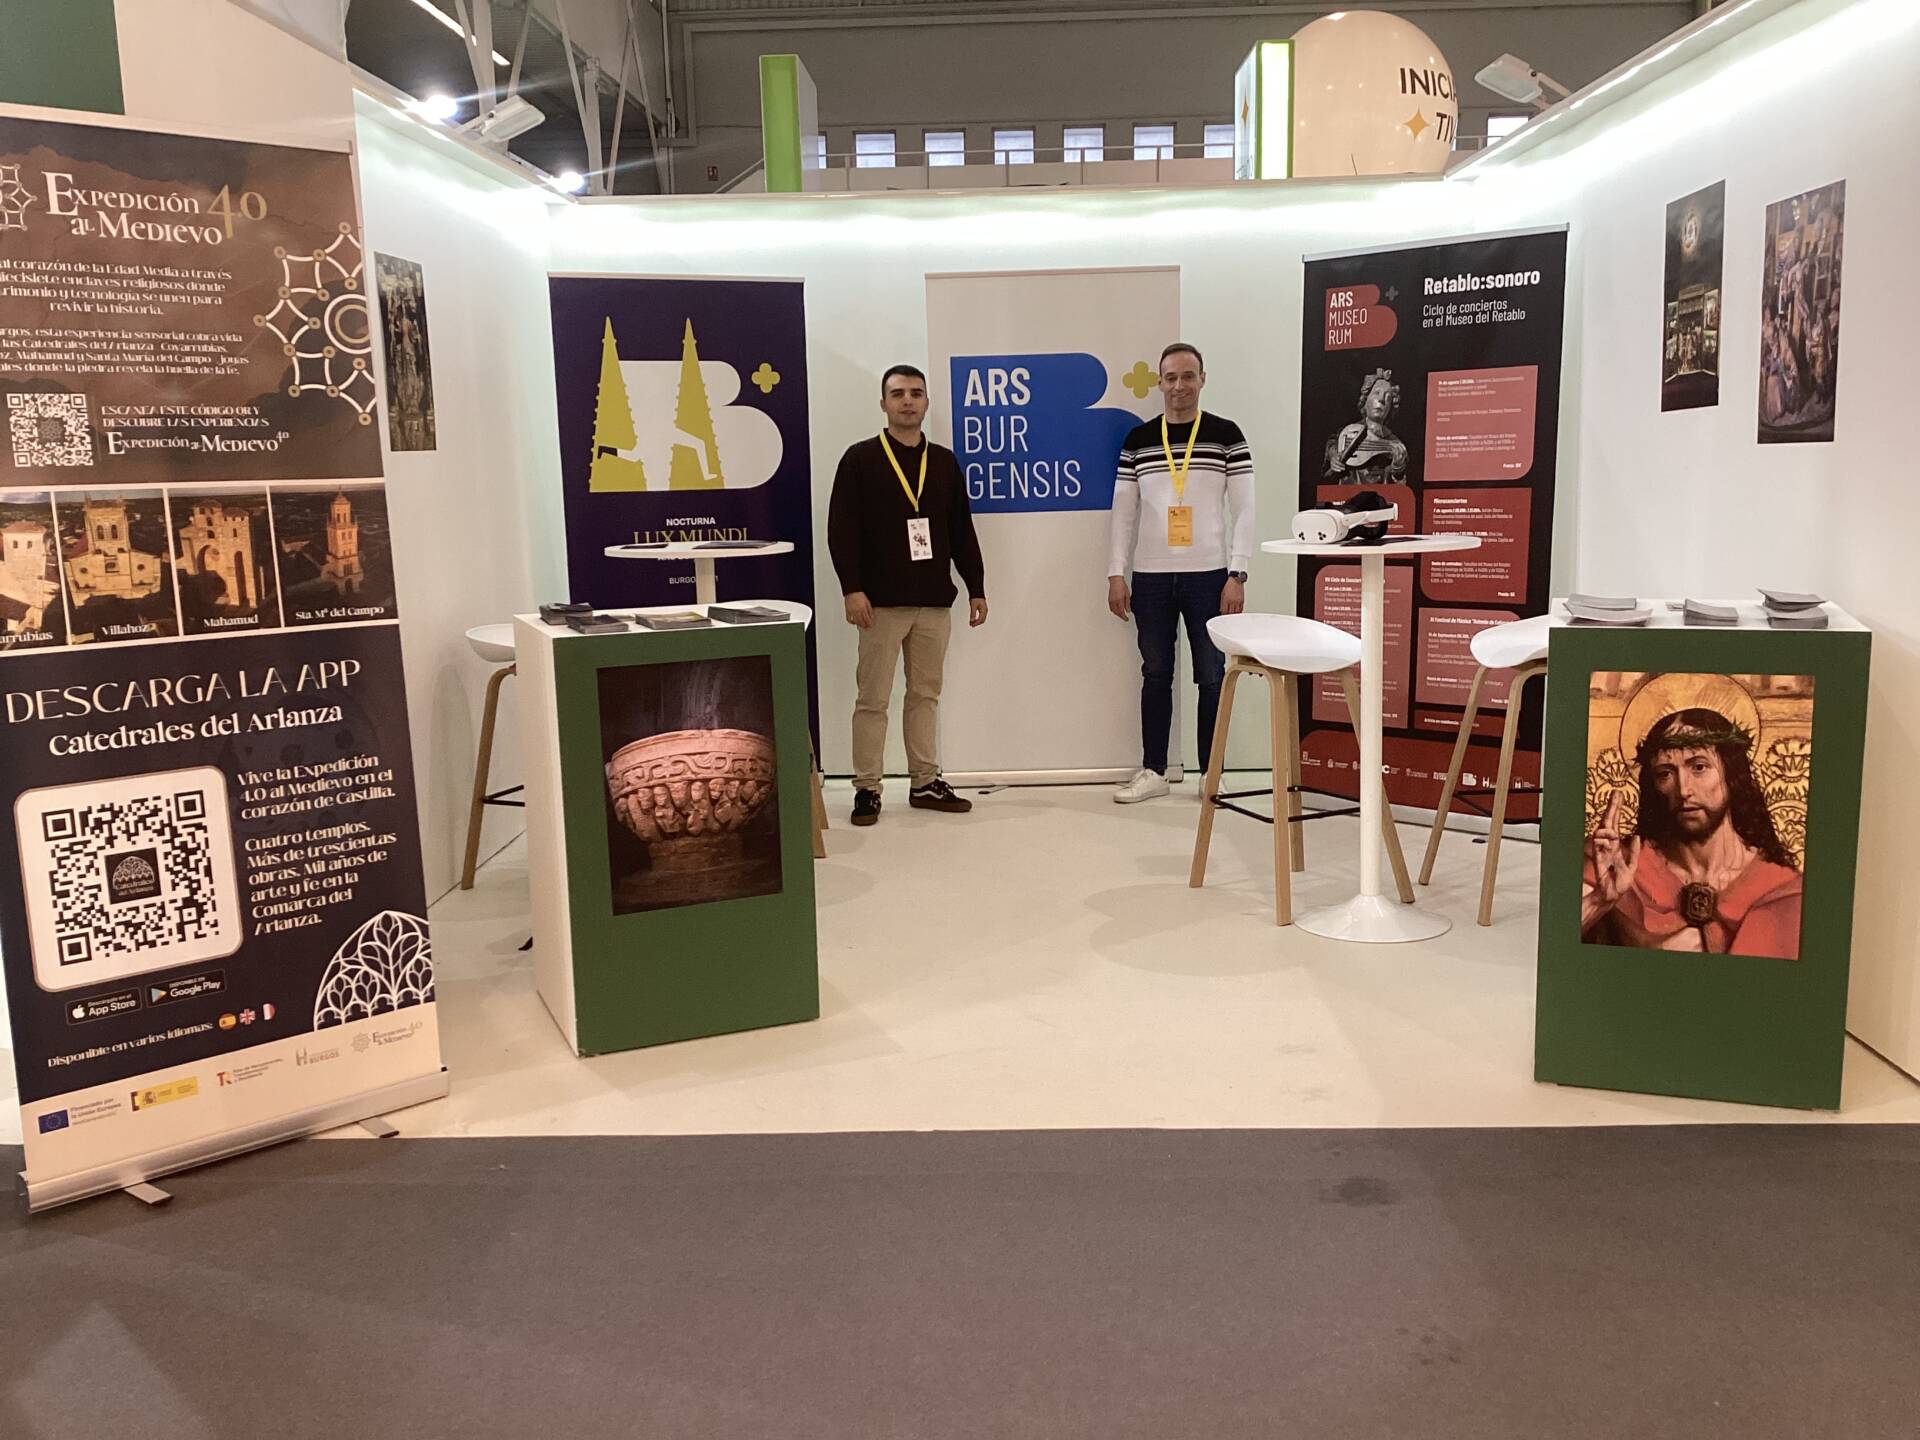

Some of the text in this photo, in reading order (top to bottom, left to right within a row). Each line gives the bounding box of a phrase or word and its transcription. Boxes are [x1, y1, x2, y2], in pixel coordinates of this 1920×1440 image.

[13, 259, 72, 271] corazón
[74, 262, 90, 272] de
[92, 263, 104, 273] la
[106, 264, 140, 275] Edad
[142, 265, 179, 277] Media
[181, 269, 189, 278] a
[191, 267, 232, 279] través
[0, 271, 226, 292] iecisiete enclaves religiosos donde
[1423, 269, 1541, 296] Retablo:sonoro
[59, 289, 69, 300] y
[70, 288, 140, 302] tecnología
[142, 293, 158, 301] se
[159, 294, 191, 303] unen
[192, 295, 222, 305] para
[1329, 291, 1354, 308] ARS
[50, 301, 165, 315] revivir la historia.
[1328, 308, 1368, 327] MUSEO
[1423, 299, 1508, 318] Ciclo de conciertos
[1422, 308, 1526, 329] en el Museo del Retablo
[22, 339, 88, 349] Catedrales
[89, 341, 107, 349] del
[35, 328, 62, 337] esta
[64, 330, 132, 339] experiencia
[134, 331, 185, 340] sensorial
[186, 332, 219, 341] cobra
[219, 332, 243, 342] vida
[1328, 329, 1352, 346] RUM
[17, 350, 75, 360] Mahamud
[76, 353, 84, 362] y
[86, 352, 120, 361] Santa
[156, 353, 173, 362] del
[24, 362, 63, 372] donde
[65, 363, 75, 372] la
[77, 364, 115, 374] piedra
[116, 364, 153, 373] revela
[154, 365, 165, 373] la
[166, 365, 198, 374] huella
[200, 365, 214, 374] de
[215, 366, 225, 375] la
[964, 367, 1031, 407] ARS
[101, 405, 157, 415] ESCANEA
[159, 405, 189, 415] ESTE
[190, 403, 234, 416] CÓDIGO
[253, 405, 260, 415] Y
[103, 417, 270, 427] DESCUBRE LAS EXPERIENCIAS
[964, 415, 1029, 454] BUR
[965, 459, 1082, 500] GENSIS
[665, 516, 716, 527] NOCTURNA
[668, 576, 696, 585] BURGO
[330, 607, 346, 617] del
[347, 605, 385, 617] Campo
[101, 623, 149, 636] Villahoz
[203, 614, 259, 628] Mahamud
[6, 659, 362, 723] DESCARGA LA APP
[49, 704, 344, 756] Catedrales del Arlanza
[237, 754, 380, 786] Vive la Expedición
[240, 769, 393, 803] 4.0 al Medievo en el
[241, 786, 397, 820] corazón de Castilla.
[244, 821, 372, 852] Cuatro templos.
[247, 833, 398, 869] Más de trescientas
[248, 850, 388, 886] obras. Mil años de
[250, 872, 360, 903] arte y fe en la
[251, 888, 353, 919] Comarca del
[253, 913, 324, 936] Arlanza.
[170, 981, 221, 997] Google Play
[88, 1000, 136, 1017] App Store
[47, 1022, 215, 1068] Disponible en varios idiomas:
